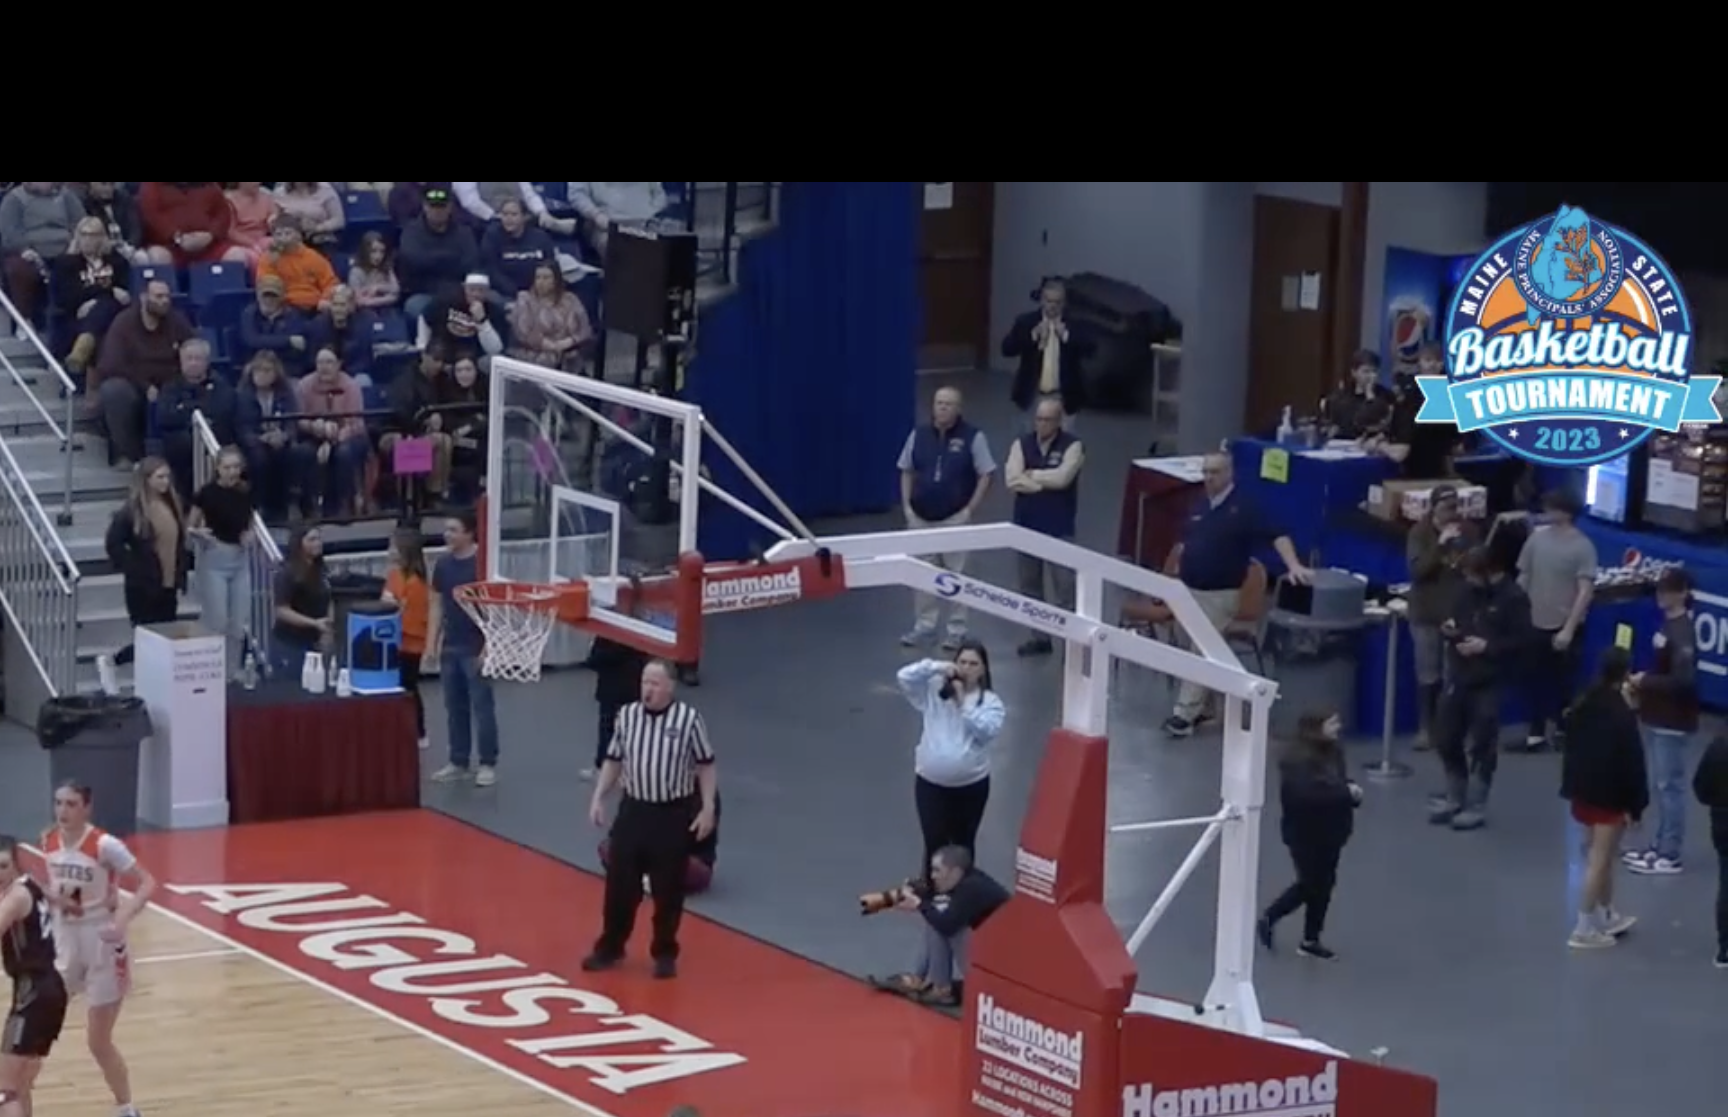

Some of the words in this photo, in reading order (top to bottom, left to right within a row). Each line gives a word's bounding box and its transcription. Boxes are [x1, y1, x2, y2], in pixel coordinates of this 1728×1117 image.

[702, 565, 801, 597] ammond
[963, 582, 1020, 610] Schelde
[1021, 601, 1067, 626] Sports
[164, 881, 748, 1094] AUGUSTA
[977, 992, 1083, 1061] Hammond
[979, 1027, 1021, 1058] Lumber
[1023, 1046, 1079, 1085] Company
